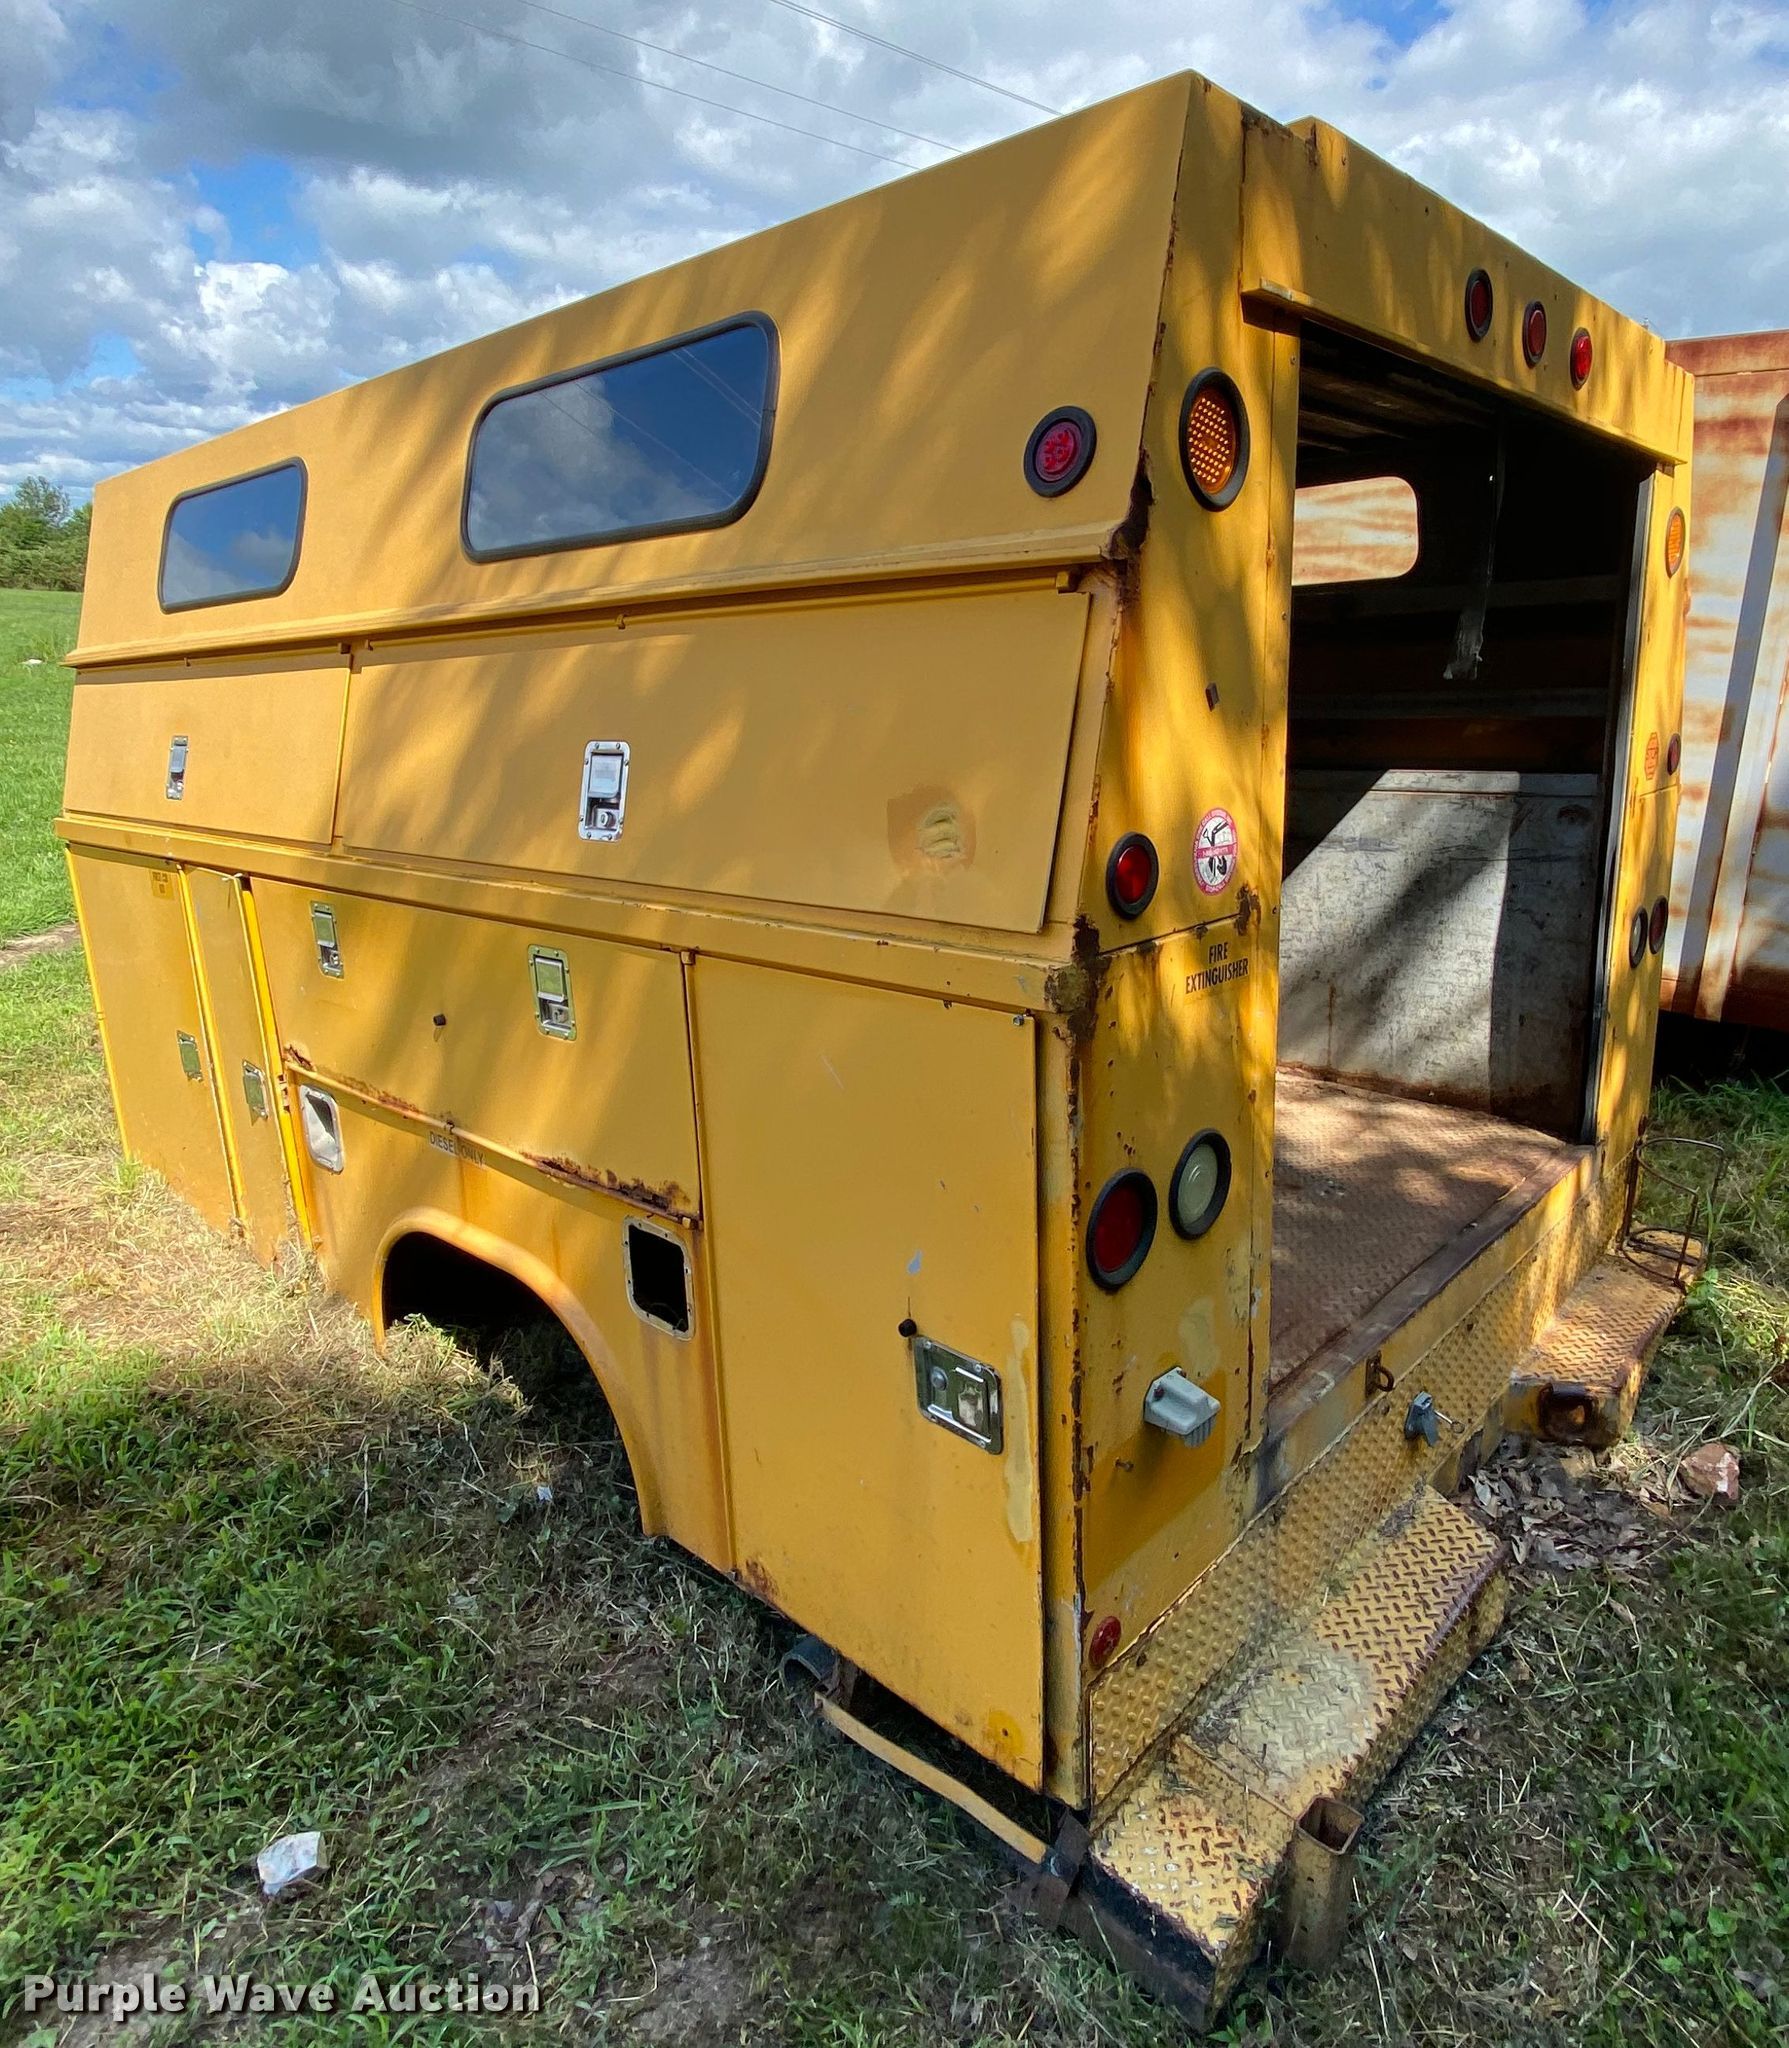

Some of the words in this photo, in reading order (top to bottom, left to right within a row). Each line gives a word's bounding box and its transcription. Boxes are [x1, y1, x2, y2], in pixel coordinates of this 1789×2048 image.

[1208, 942, 1228, 964] FIRE
[1185, 957, 1249, 995] EXTINGUISHER
[429, 1131, 460, 1156] DIESEL
[460, 1144, 484, 1167] ONLY
